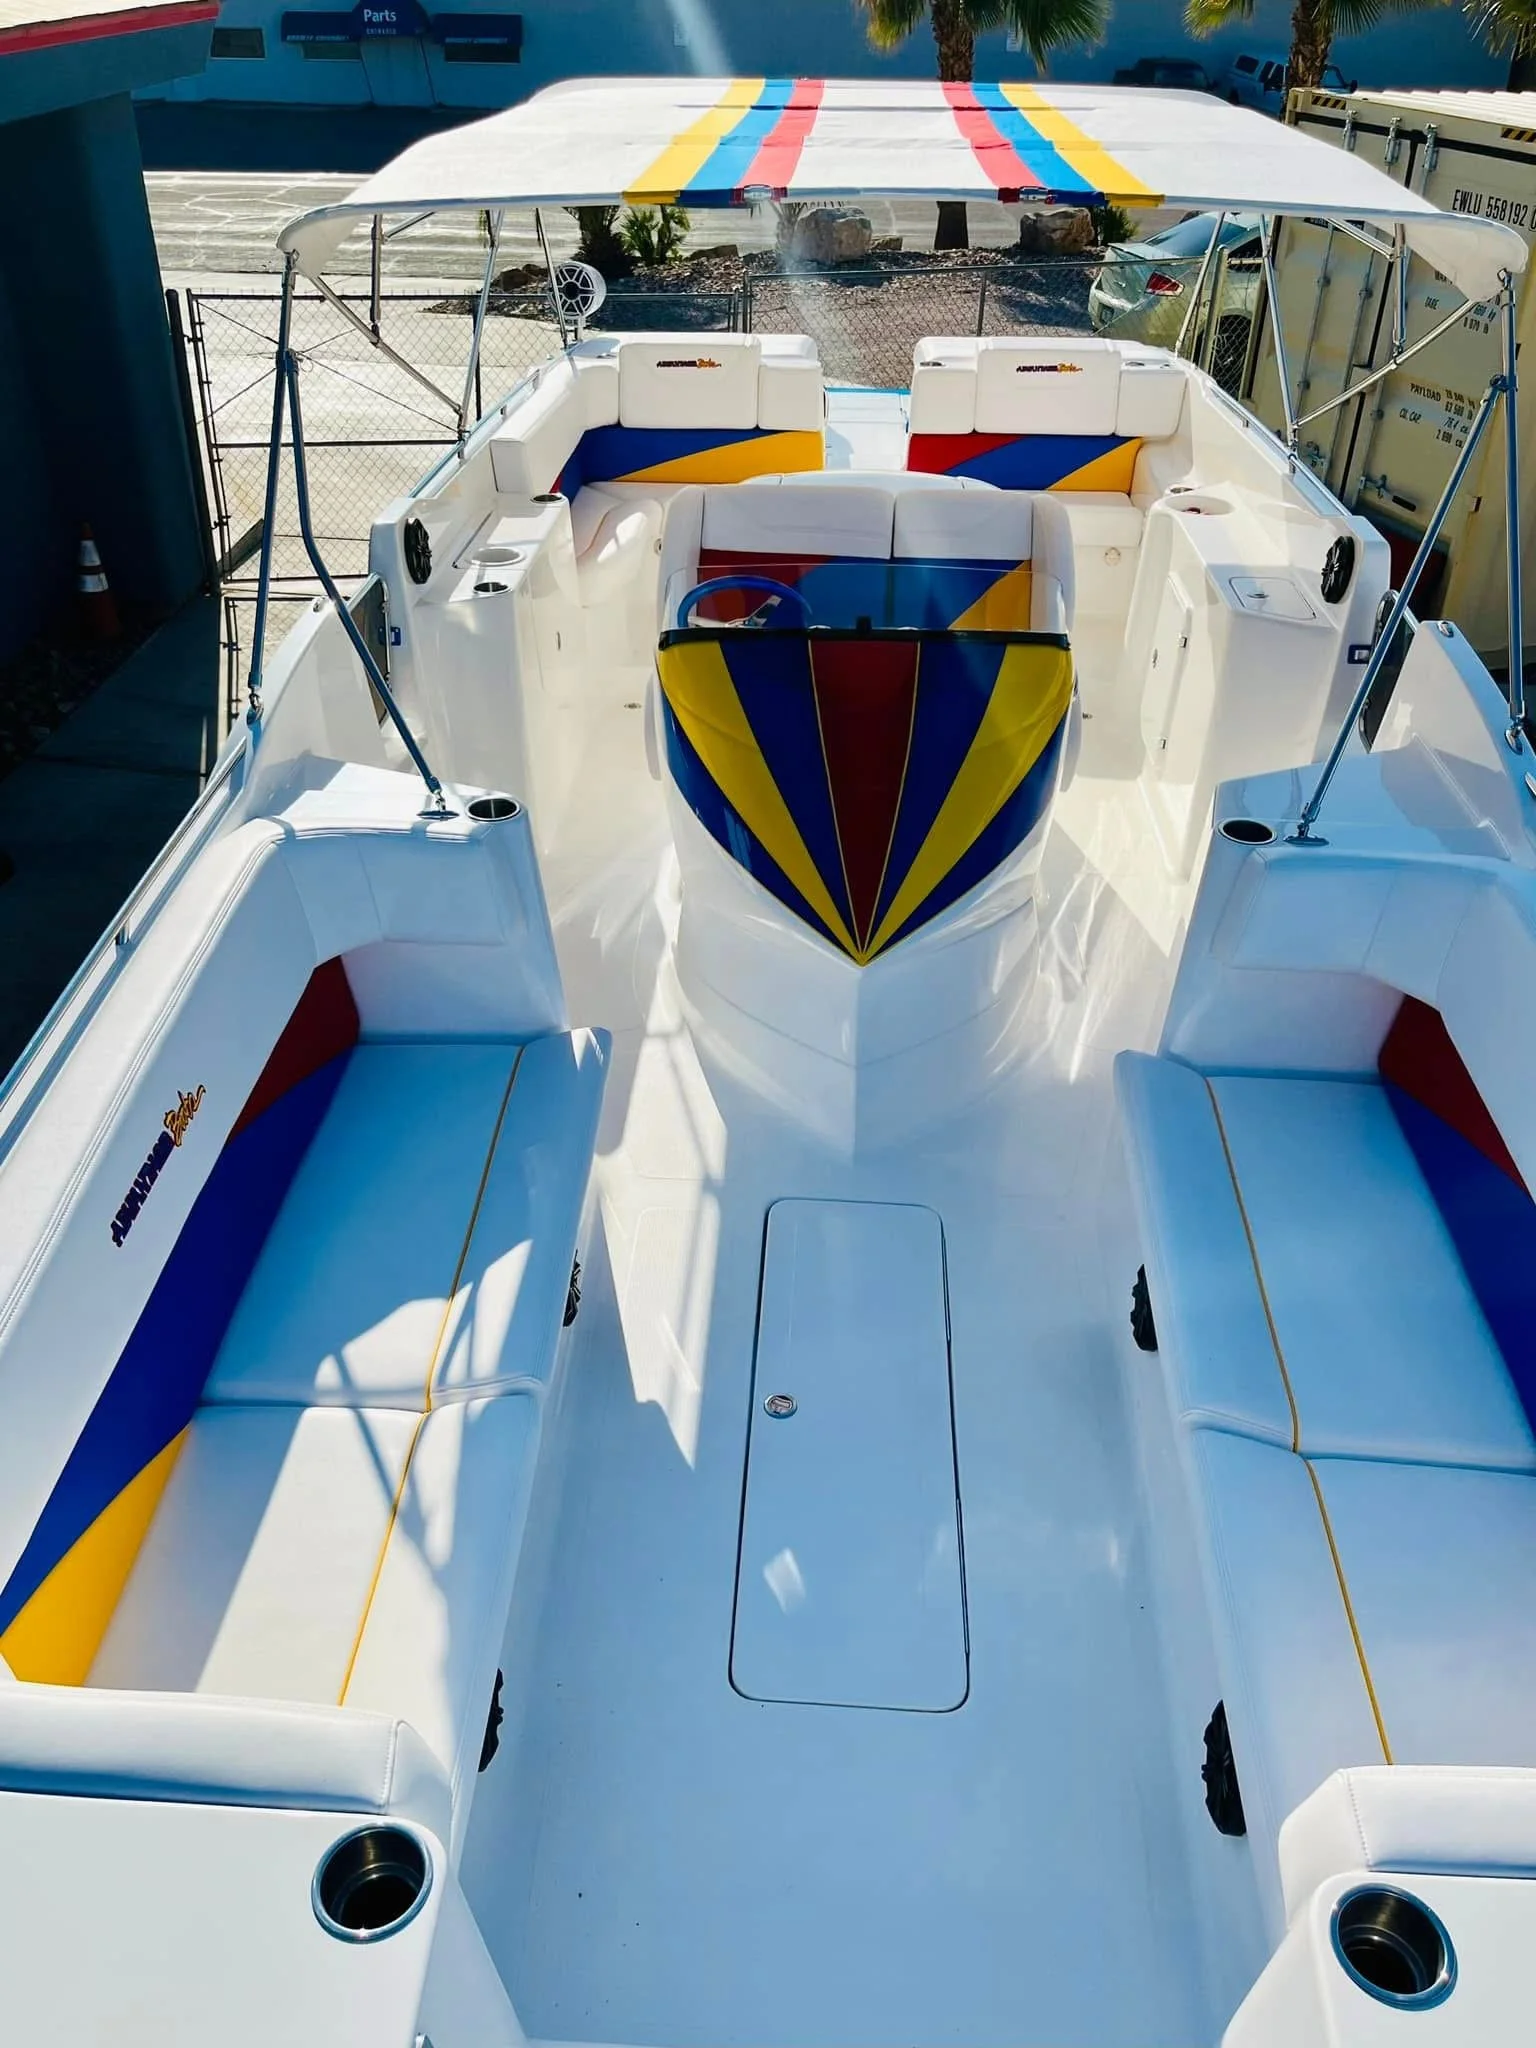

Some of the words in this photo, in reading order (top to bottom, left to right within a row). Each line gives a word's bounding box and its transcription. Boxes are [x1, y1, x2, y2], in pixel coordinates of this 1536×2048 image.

[363, 9, 397, 22] Parts
[1452, 189, 1483, 215] EWLU
[1486, 196, 1528, 227] 558192
[1409, 383, 1442, 402] PAYLOAD
